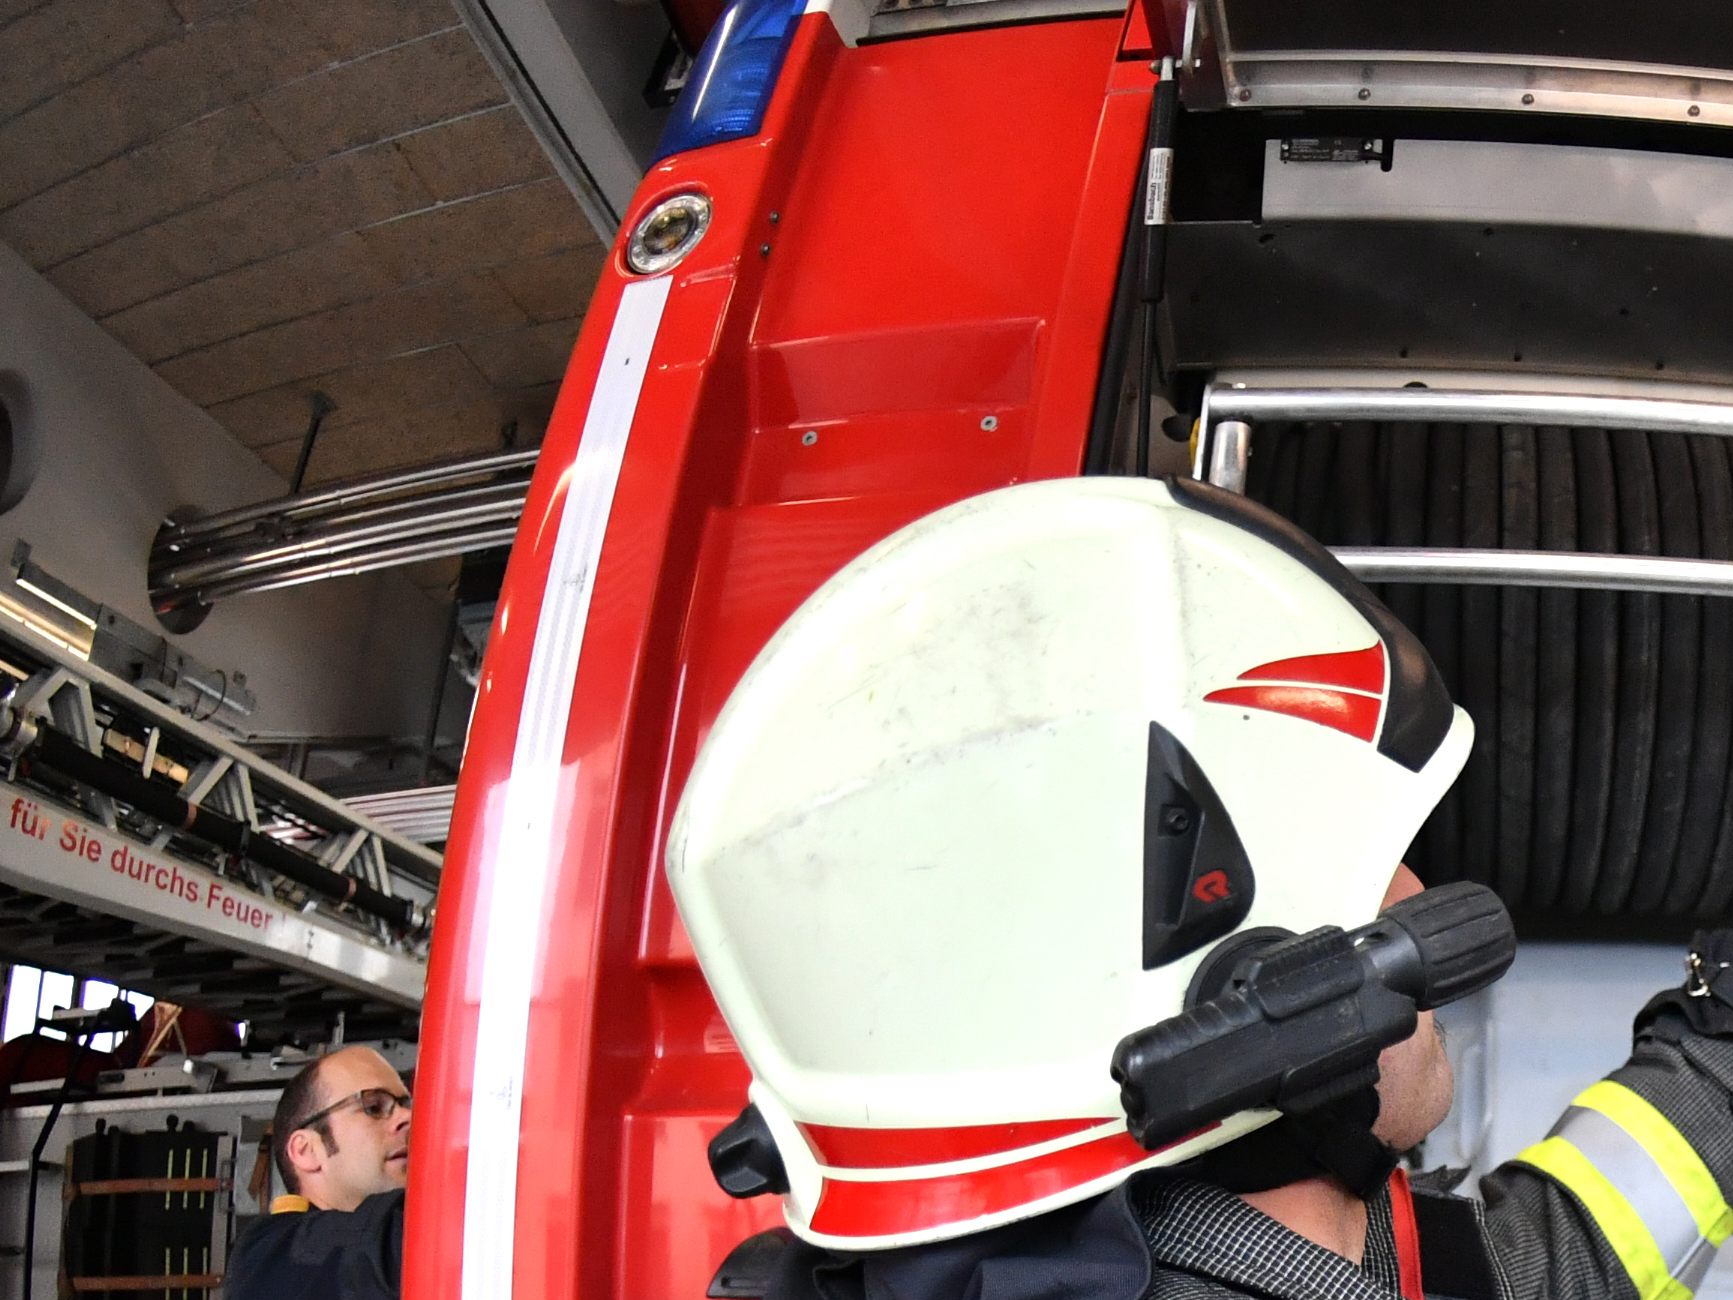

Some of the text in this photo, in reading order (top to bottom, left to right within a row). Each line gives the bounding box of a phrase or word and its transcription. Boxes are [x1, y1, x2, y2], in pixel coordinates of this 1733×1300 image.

[9, 798, 274, 929] für Sie durchs Feuer
